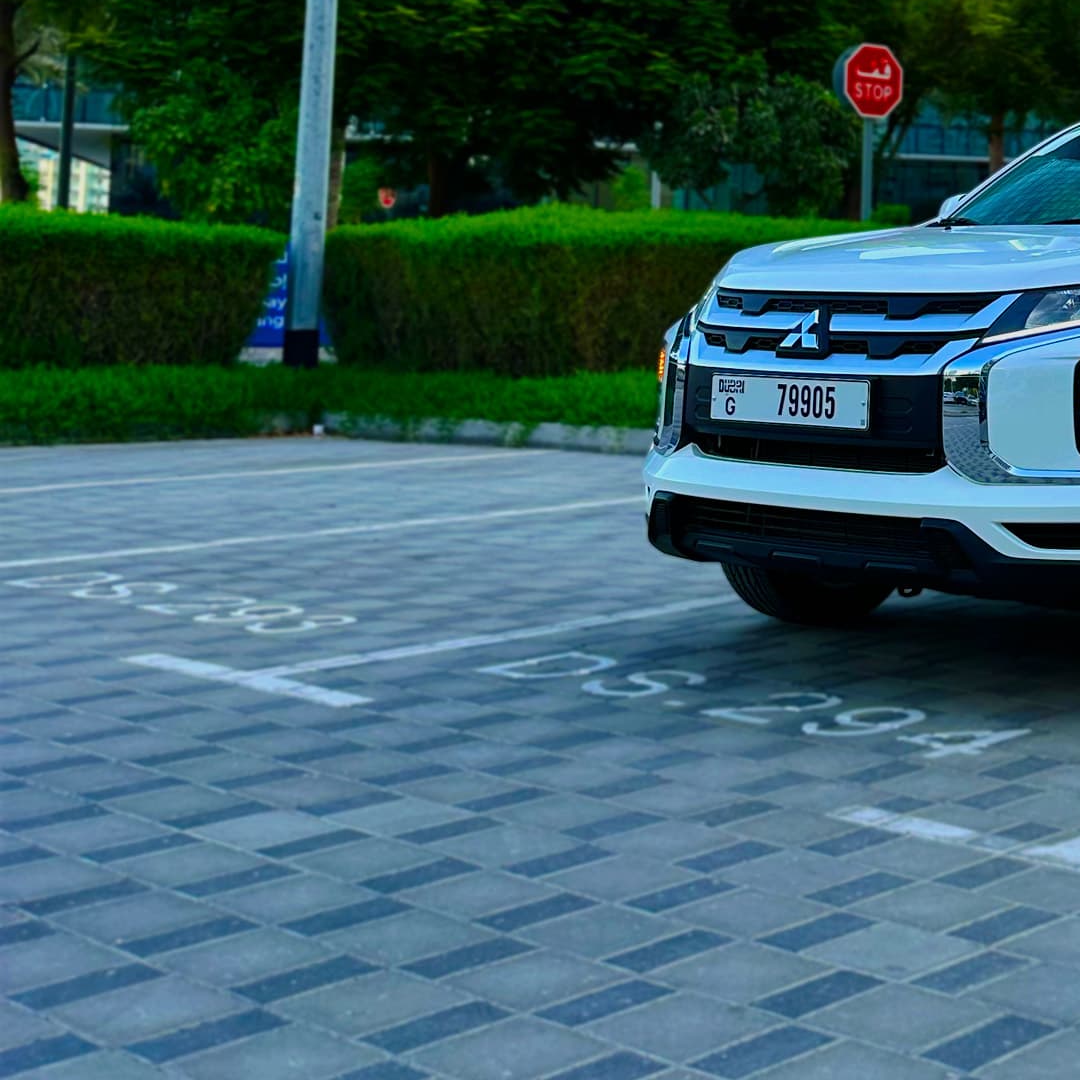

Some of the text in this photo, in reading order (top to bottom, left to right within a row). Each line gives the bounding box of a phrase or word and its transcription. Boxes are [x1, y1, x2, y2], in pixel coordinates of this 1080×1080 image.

[854, 81, 892, 100] STOP
[725, 396, 736, 416] G
[777, 383, 836, 419] 79905
